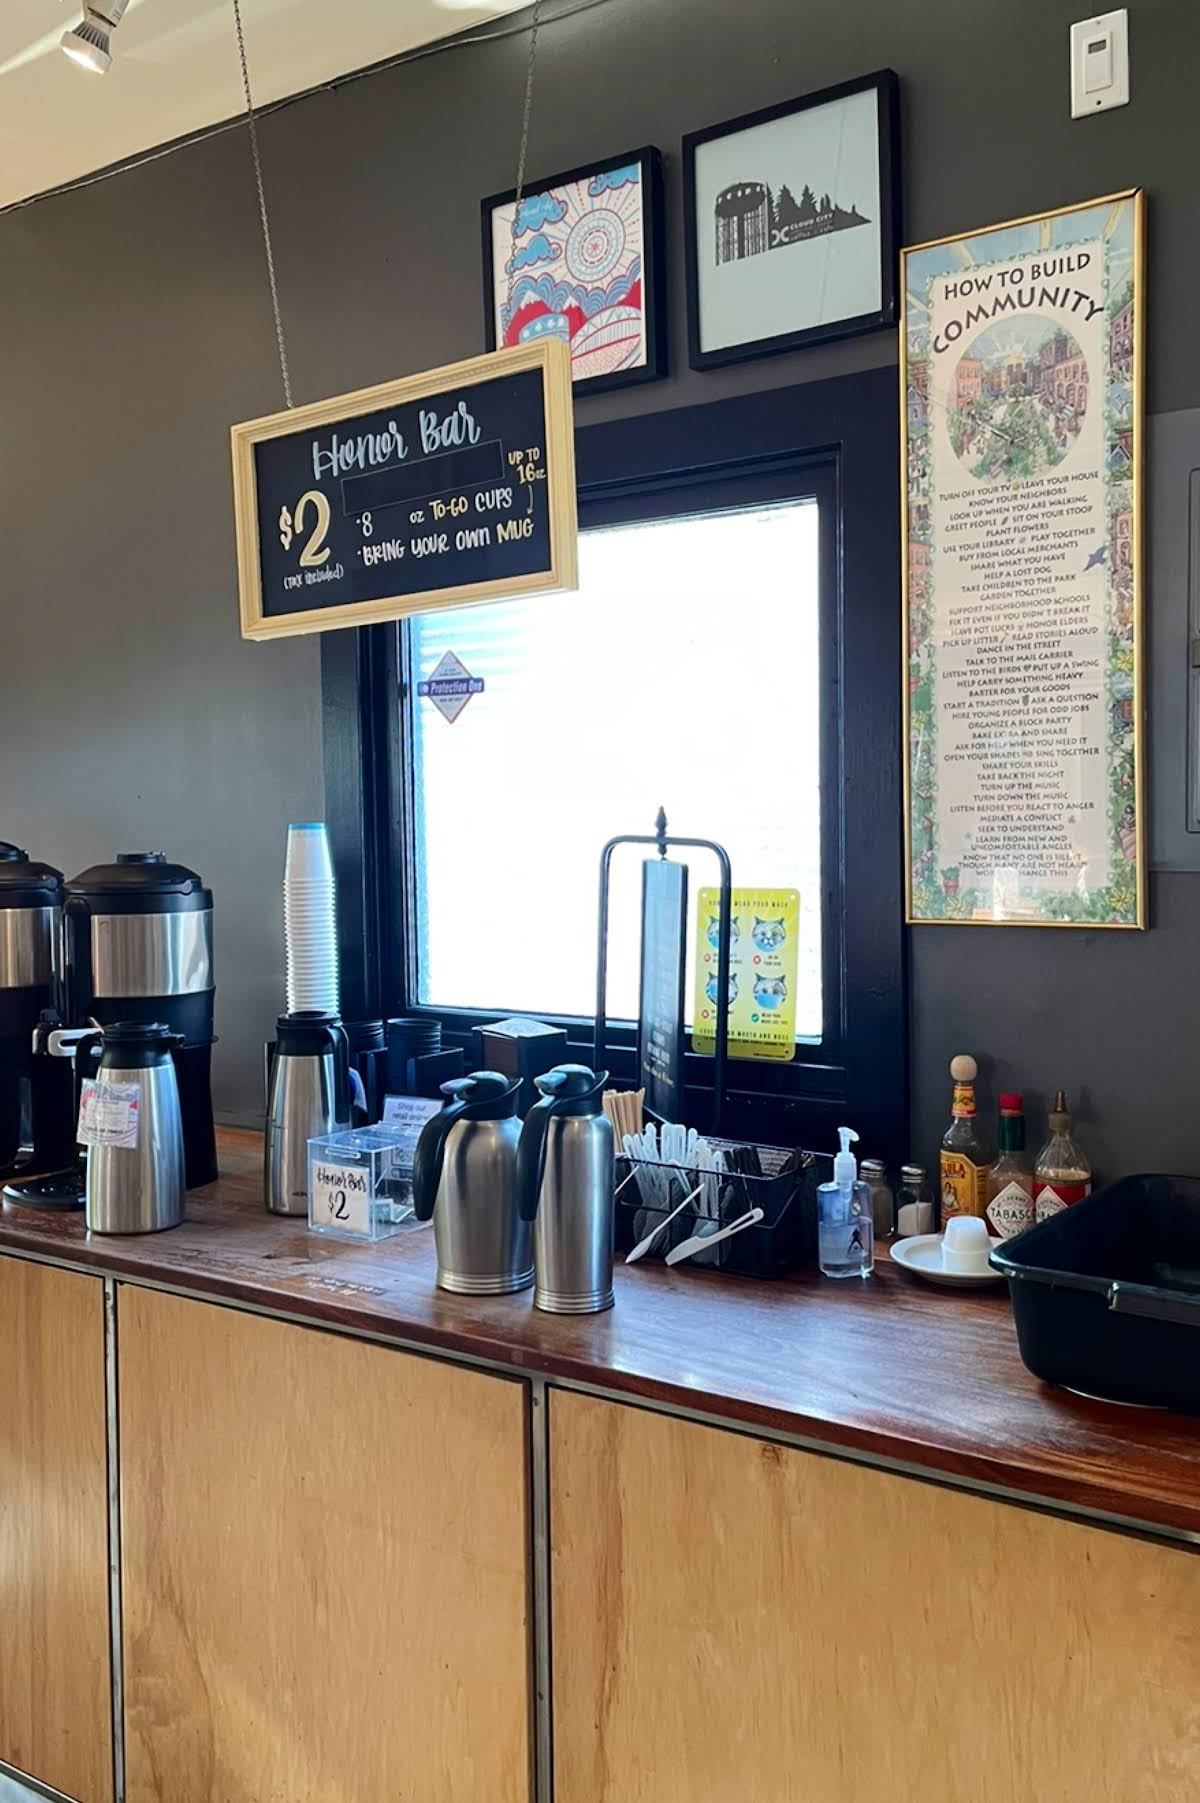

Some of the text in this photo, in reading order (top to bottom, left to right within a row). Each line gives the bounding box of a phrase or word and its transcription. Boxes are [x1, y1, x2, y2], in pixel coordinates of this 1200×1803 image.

[789, 213, 834, 230] CLOUD CITY
[945, 253, 1090, 300] HOW TO BUILD
[933, 286, 1104, 354] COMMUNITY
[312, 401, 481, 480] Honor Bar
[508, 447, 540, 465] UP TO
[939, 471, 1098, 501] TURN OFF YOUR TV LEAVE YOUR HOUSE
[409, 510, 424, 523] oz
[429, 496, 468, 520] TO-GO
[475, 487, 512, 512] CUPS
[968, 486, 1066, 507] KNOW YOUR NEIGHBORS
[949, 495, 1087, 520] LOOK UP WHEN YOU ARE WALKING
[279, 490, 331, 567] $2
[985, 522, 1048, 536] PLANT FLOWERS
[362, 539, 405, 566] BRING
[411, 533, 450, 558] YOUR
[497, 518, 534, 544] MUG
[942, 527, 1094, 553] USE YOUR LIBRARY PLAY TOGETHER
[958, 540, 1078, 561] BUY FROM LOCAL MERCHANTS
[970, 553, 1065, 570] SHARE WHAT YOU HAVE
[983, 565, 1051, 580] HELP A LOST DOG
[961, 584, 980, 592] TAKE
[981, 579, 1021, 590] CHILDREN
[1036, 576, 1051, 584] THE
[1054, 573, 1075, 582] PARK
[976, 639, 1060, 654] DANCE IN THE STREET
[965, 651, 1072, 665] TALK TO THE MAIL CARRIER
[942, 669, 967, 678] LISTEN
[969, 668, 979, 676] TO
[980, 667, 995, 675] THE
[998, 665, 1021, 673] BIRDS
[1032, 663, 1048, 671] PUT
[1071, 659, 1098, 668] SWING
[431, 682, 467, 694] Protection
[956, 671, 1083, 687] HELP CARRY SOMETHING HEAVY
[968, 688, 998, 696] BARTER
[1017, 685, 1039, 693] YOUR
[1041, 683, 1070, 692] GOODS
[944, 701, 965, 709] START
[975, 697, 1019, 707] TRADITION
[1031, 696, 1046, 704] ASK
[1048, 695, 1054, 703] A
[1055, 693, 1099, 702] QUESTION
[951, 711, 970, 719] HIRE
[971, 709, 1000, 718] YOUNG
[1002, 707, 1030, 716] PEOPLE
[1049, 705, 1068, 713] ODD
[1070, 704, 1089, 712] JOBS
[968, 719, 1008, 728] ORGANIZE
[1018, 718, 1043, 726] BLOCK
[1045, 716, 1072, 725] PARTY
[328, 1190, 350, 1220] $2
